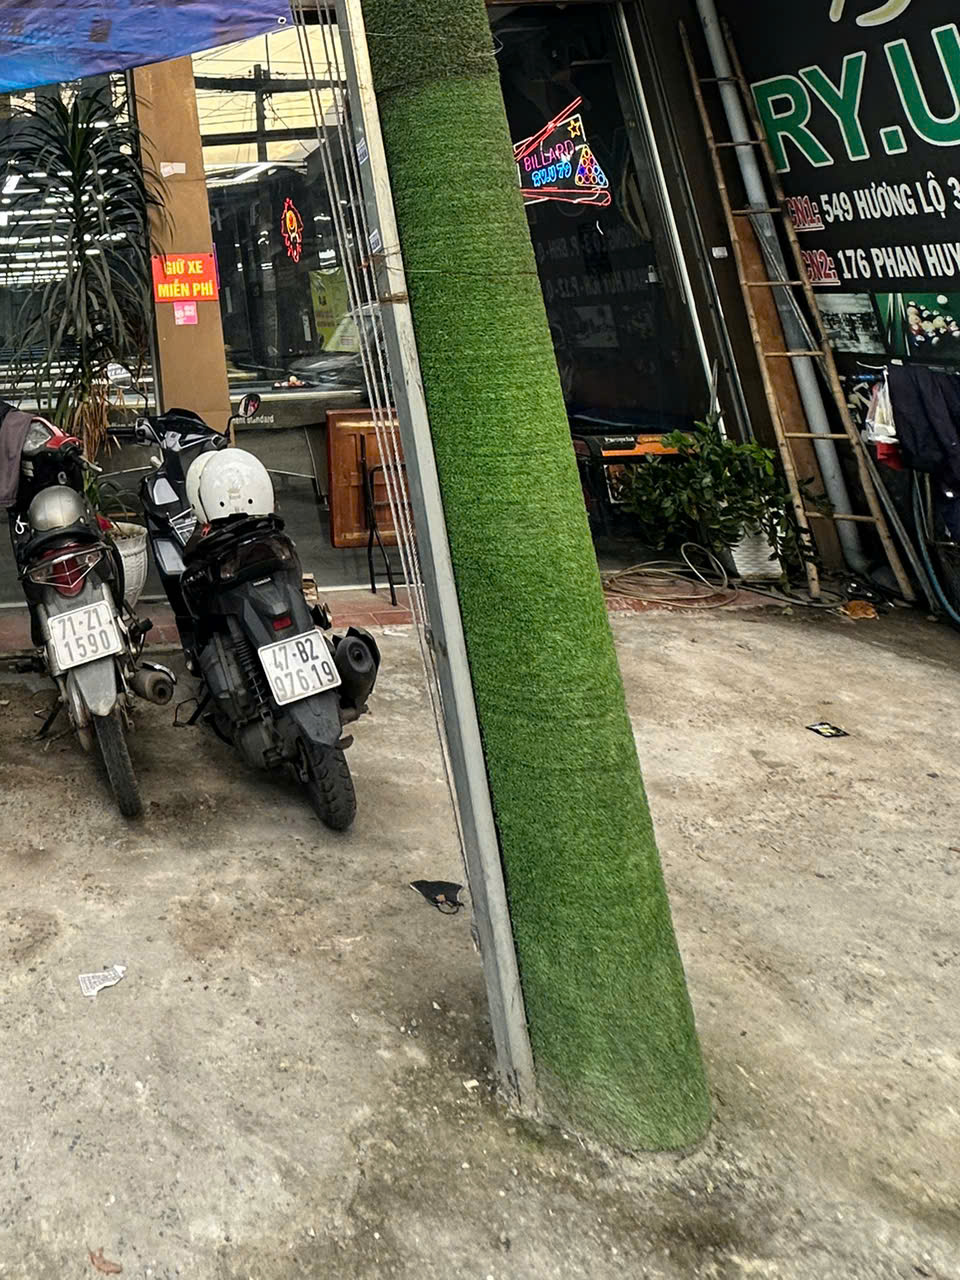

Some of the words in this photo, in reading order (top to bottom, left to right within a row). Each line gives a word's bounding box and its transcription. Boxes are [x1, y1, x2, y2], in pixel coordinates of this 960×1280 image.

[523, 139, 575, 172] BILLARD
[821, 190, 854, 223] 549
[853, 180, 919, 219] HƯƠNG
[916, 171, 946, 219] LỘ
[187, 260, 204, 275] XE
[836, 248, 871, 280] 176
[870, 245, 924, 278] PHAN
[192, 280, 214, 297] PHÍ
[58, 607, 102, 641] 71-Z1
[64, 629, 111, 662] 1590
[271, 638, 319, 672] 47-B2
[274, 660, 336, 699] 976.19
